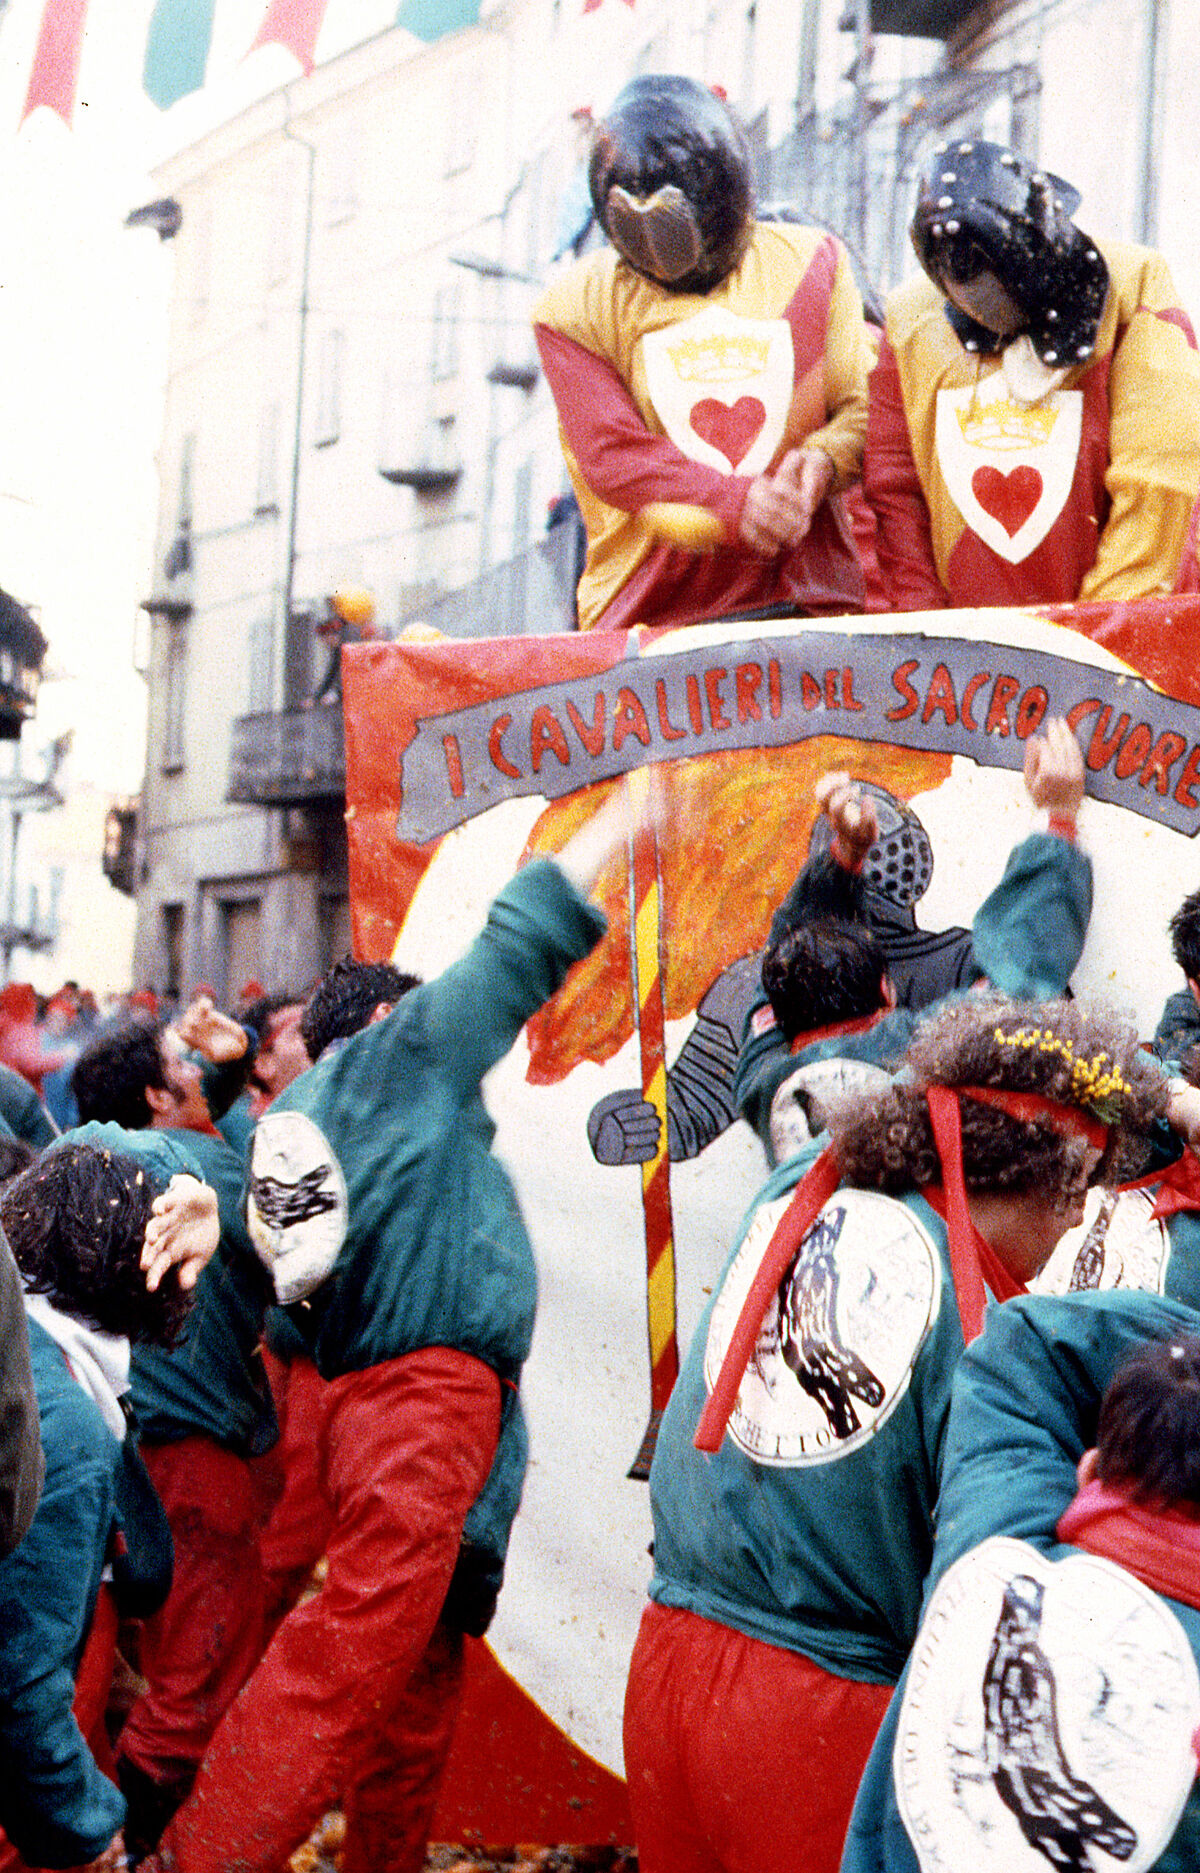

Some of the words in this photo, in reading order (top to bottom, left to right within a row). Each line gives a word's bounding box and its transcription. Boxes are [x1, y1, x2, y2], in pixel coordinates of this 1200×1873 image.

[442, 734, 465, 799] I
[487, 658, 784, 780] CAVALIERI
[800, 667, 864, 710] DEL
[884, 659, 1049, 740] SACRO
